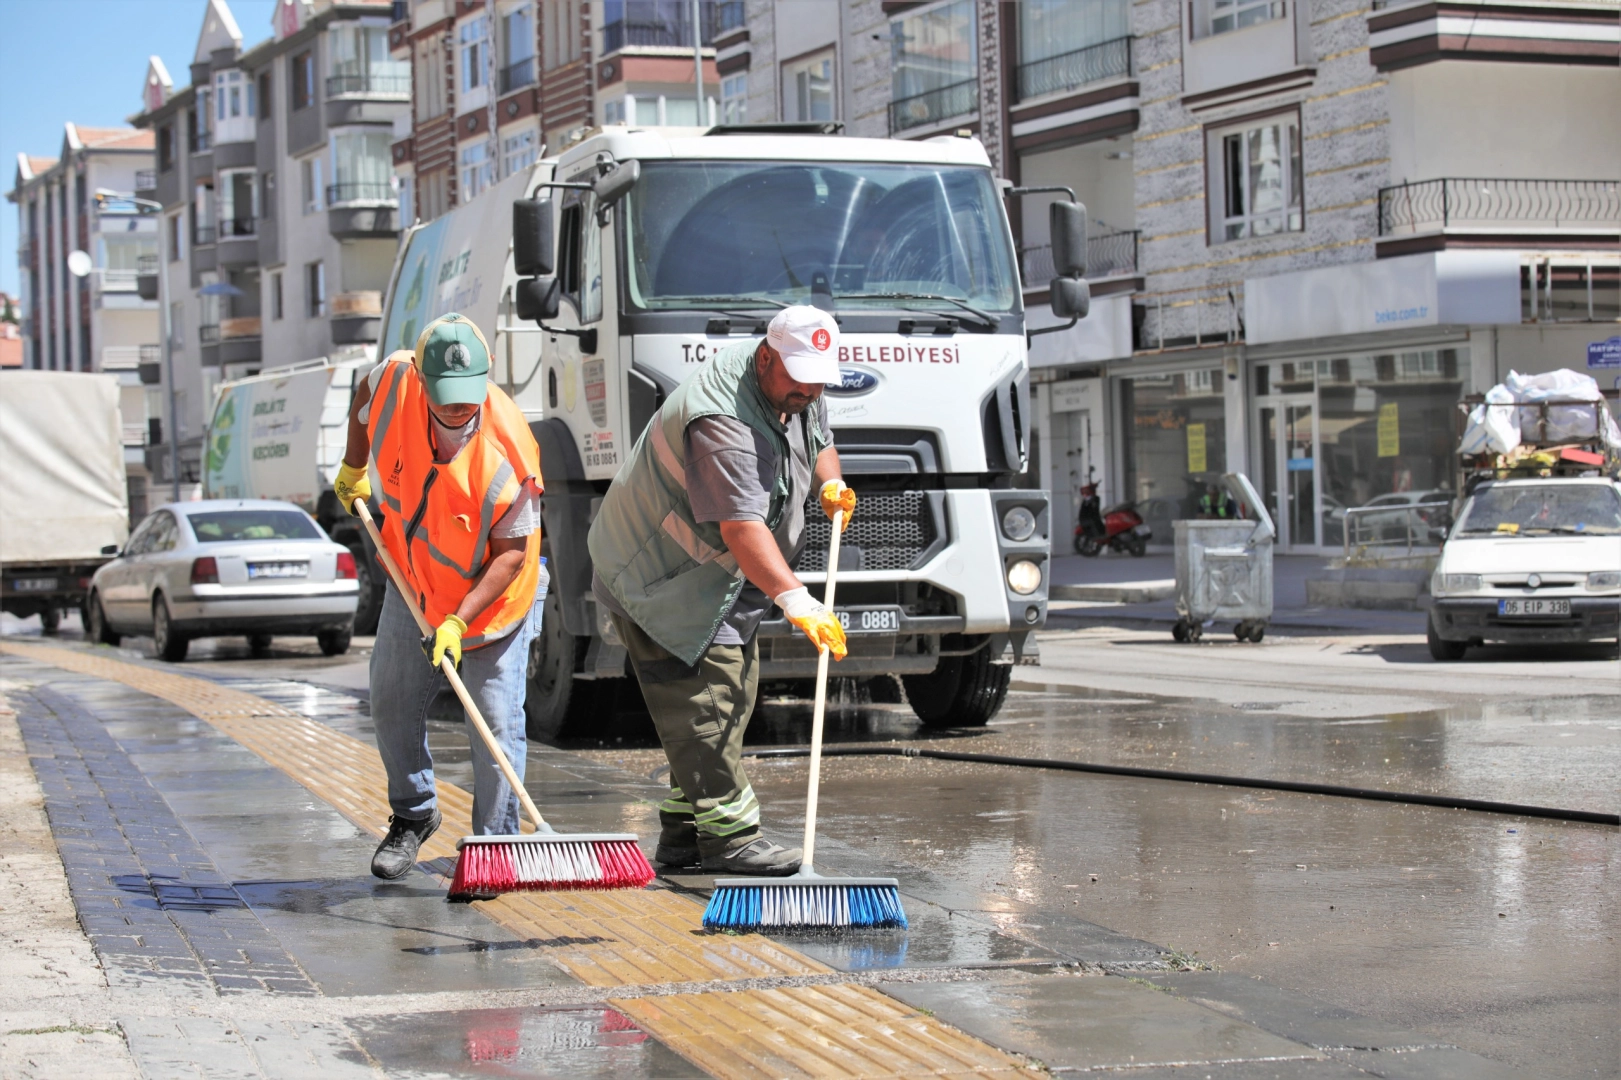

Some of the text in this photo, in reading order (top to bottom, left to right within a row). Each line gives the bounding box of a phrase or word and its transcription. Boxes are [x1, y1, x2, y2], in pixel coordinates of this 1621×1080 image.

[682, 343, 960, 364] T.C BELEDİYESİ
[593, 454, 600, 466] KB
[601, 452, 618, 465] 0881
[1505, 602, 1518, 613] 06
[1550, 602, 1569, 613] 338
[862, 611, 896, 629] 0881
